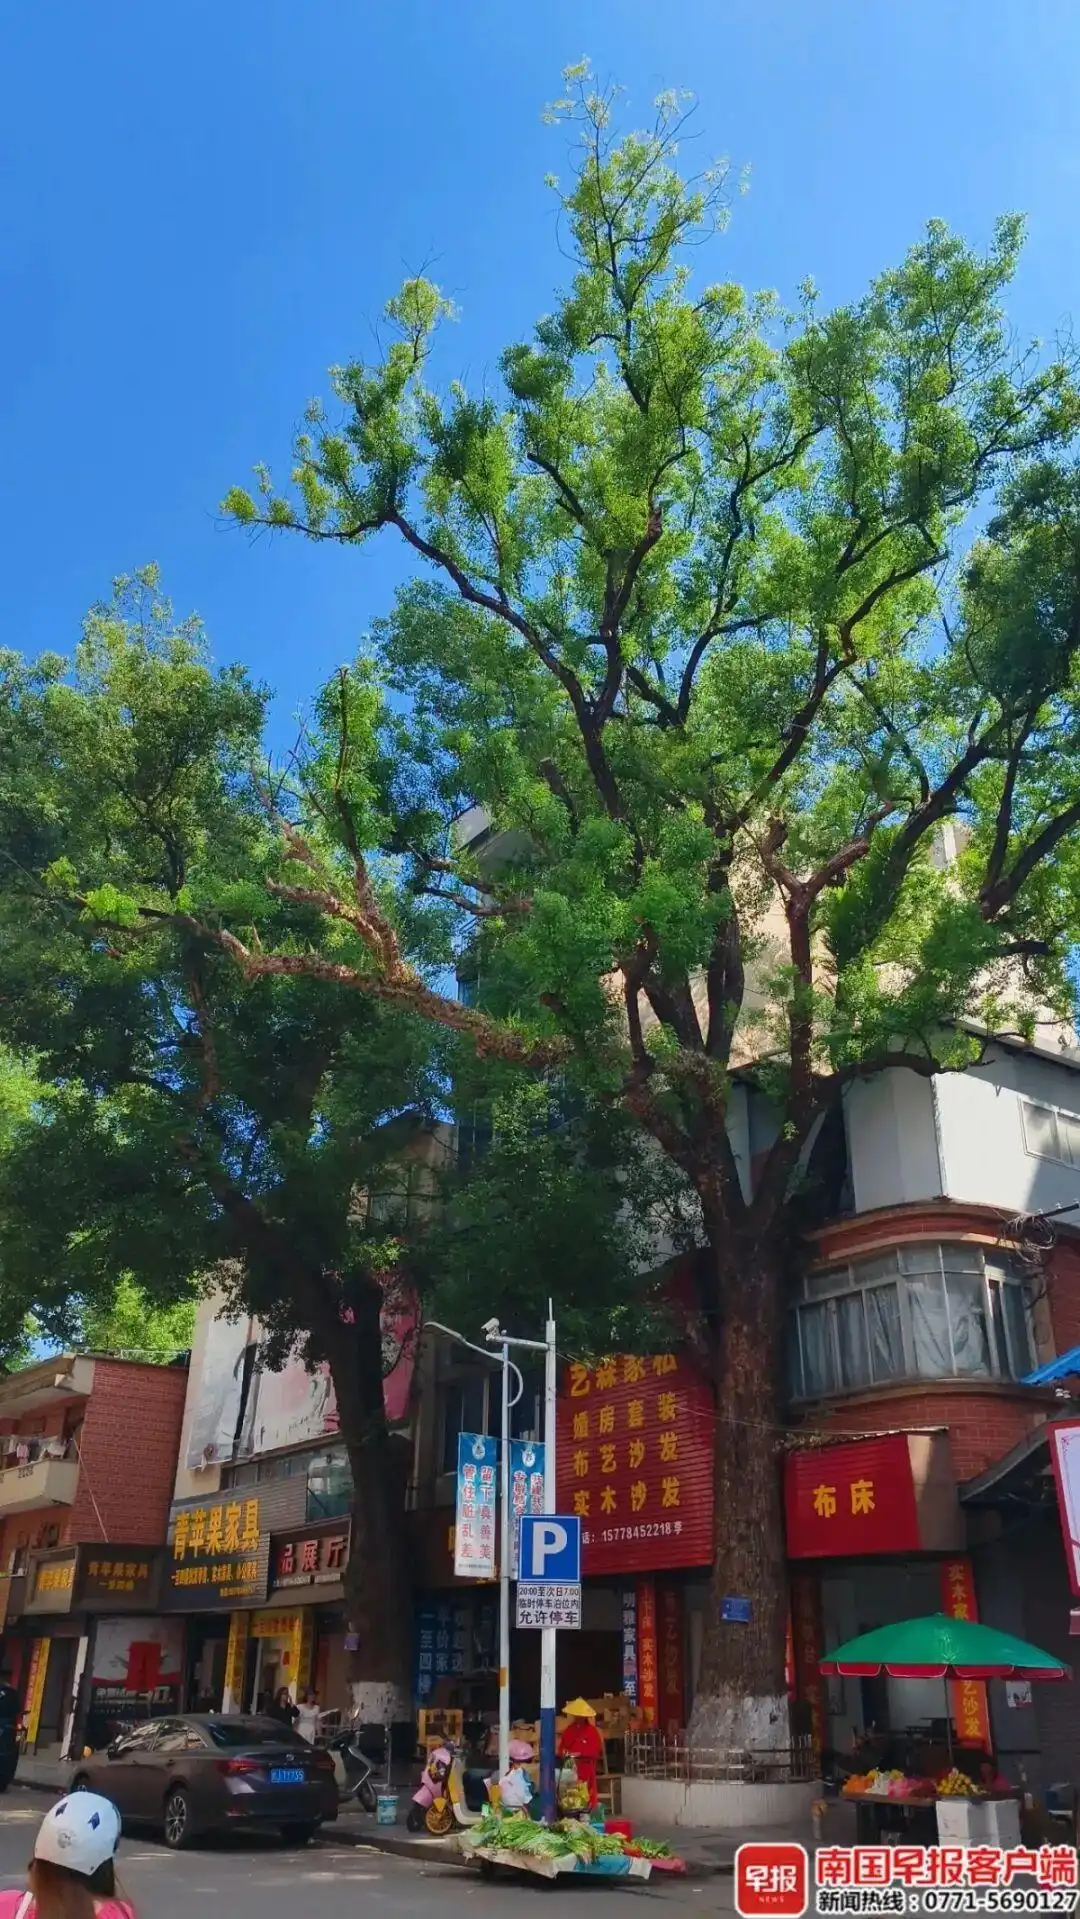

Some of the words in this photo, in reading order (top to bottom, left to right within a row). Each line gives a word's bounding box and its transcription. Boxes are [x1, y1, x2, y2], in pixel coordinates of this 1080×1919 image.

[573, 1431, 678, 1477] 布艺沙发
[460, 1463, 477, 1559] 管住脏乱差
[479, 1465, 494, 1560] 留下真善美
[574, 1476, 680, 1517] 实木沙发
[813, 1479, 876, 1518] 布床
[173, 1498, 260, 1561] 青苹果家具
[532, 1522, 568, 1576] P
[519, 1587, 580, 1597] 20:00至次日7:00
[519, 1599, 580, 1610] 临时停车泊位内
[519, 1610, 580, 1625] 允许停车
